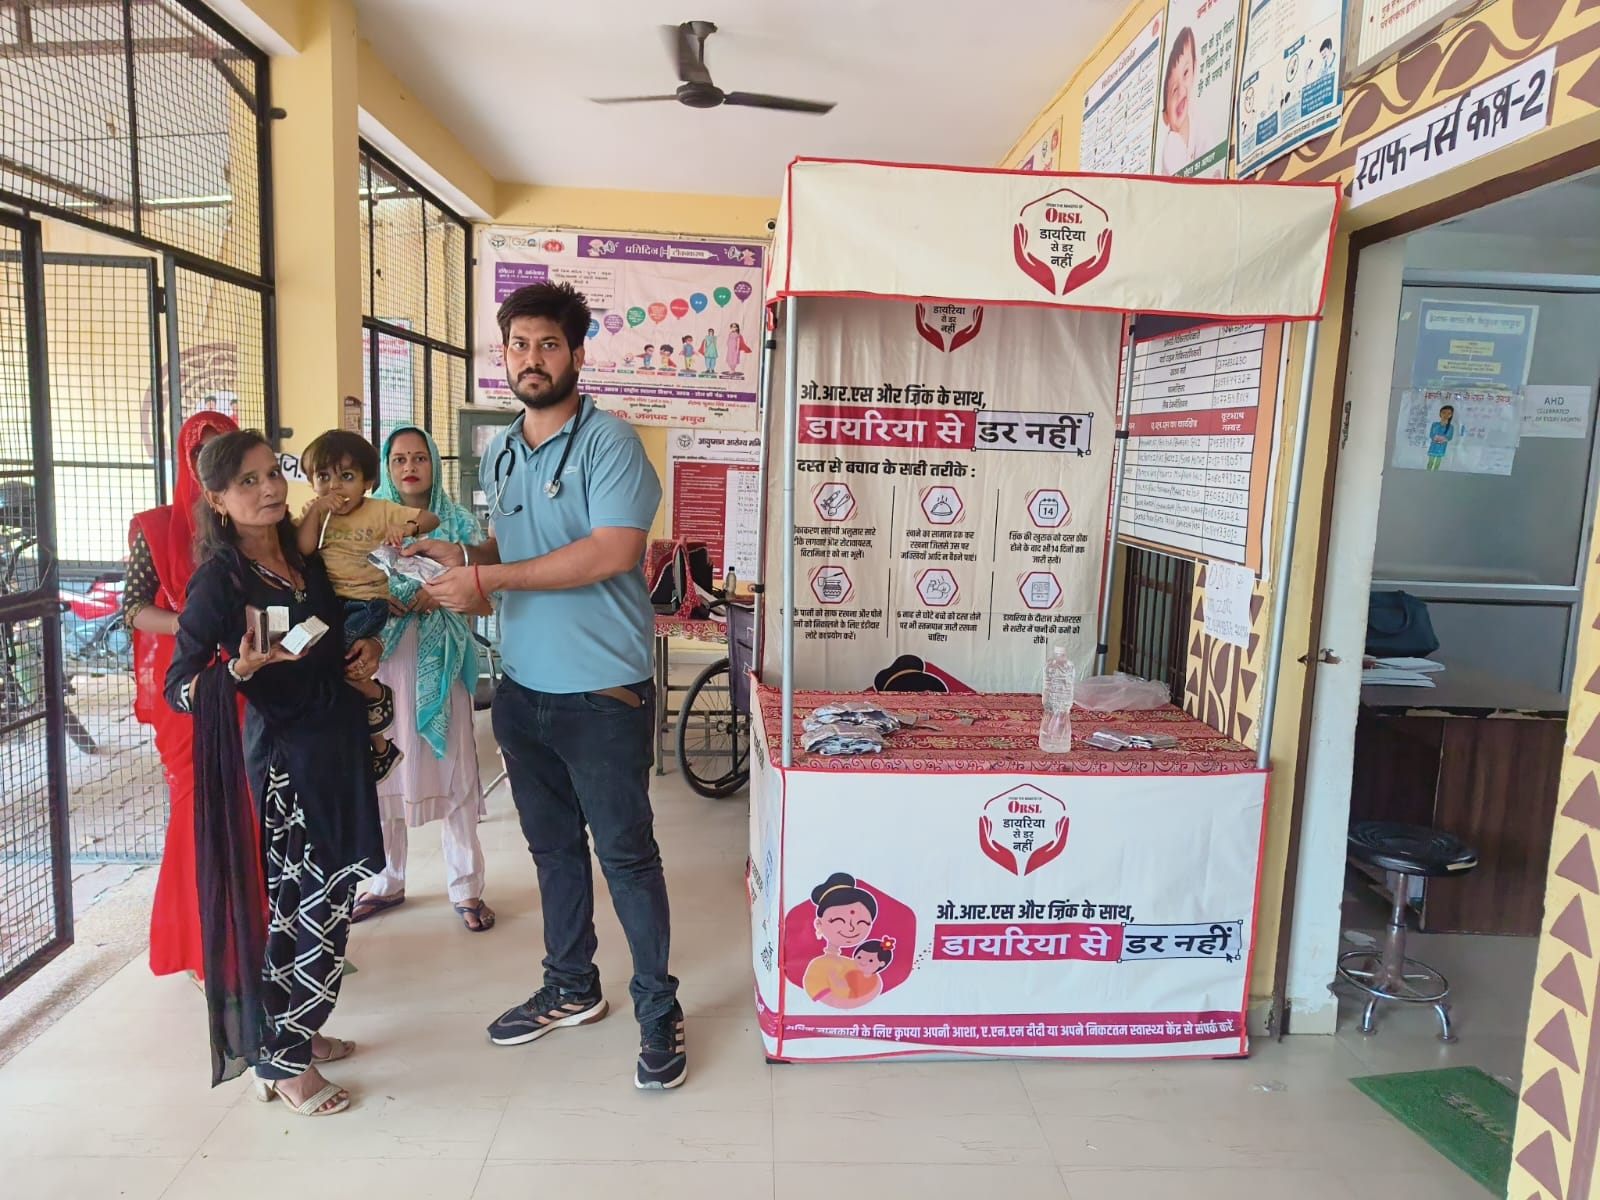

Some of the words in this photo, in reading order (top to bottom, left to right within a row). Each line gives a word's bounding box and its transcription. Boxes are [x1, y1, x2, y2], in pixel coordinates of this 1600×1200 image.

[1045, 207, 1083, 224] ORSL
[1040, 226, 1086, 241] डायरिया
[1050, 241, 1059, 252] से
[1061, 244, 1073, 252] डर
[1050, 253, 1074, 268] नहीं
[933, 304, 965, 315] डायरिया
[940, 323, 956, 334] नहीं
[800, 380, 872, 402] ओ.आर.एस
[876, 382, 901, 403] और
[904, 382, 934, 406] ज़िंक
[936, 385, 949, 405] के
[952, 388, 986, 409] साथ,
[1544, 396, 1564, 406] AHD
[806, 409, 928, 443] डायरिया
[935, 412, 966, 444] से
[978, 421, 1019, 444] डर
[1024, 415, 1082, 449] नहीं
[797, 458, 825, 475] दस्त
[828, 457, 842, 473] से
[846, 460, 879, 475] बचाव
[882, 459, 896, 475] के
[900, 460, 927, 476] सही
[930, 460, 968, 478] तरीके
[1043, 506, 1053, 516] 14
[1008, 801, 1042, 814] ORSL
[1003, 815, 1045, 829] डायरिया
[1013, 828, 1021, 838] से
[1023, 830, 1034, 838] डर
[1013, 839, 1034, 852] नहीं
[936, 900, 1015, 920] ओ.आर.एस
[1017, 899, 1045, 920] और
[1048, 898, 1079, 923] ज़िंक
[1081, 900, 1095, 920] के
[1098, 902, 1135, 923] साथ,
[941, 926, 1071, 957] डायरिया
[1079, 926, 1112, 957] से
[1124, 935, 1168, 954] डर
[1174, 924, 1233, 955] नहीं
[861, 1024, 871, 1038] के
[873, 1024, 892, 1038] लिए
[894, 1026, 921, 1041] कृपया
[923, 1024, 950, 1039] अपनी
[953, 1025, 979, 1040] आशा,
[1026, 1022, 1044, 1037] दीदी
[1048, 1023, 1058, 1037] या
[1061, 1022, 1083, 1037] अपने
[1086, 1021, 1128, 1037] निकटतम
[1130, 1023, 1164, 1036] स्वास्थ्य
[1166, 1020, 1182, 1036] केंद्र
[1184, 1020, 1194, 1035] से
[1195, 1018, 1218, 1034] संपर्क
[1219, 1018, 1235, 1033] करें
